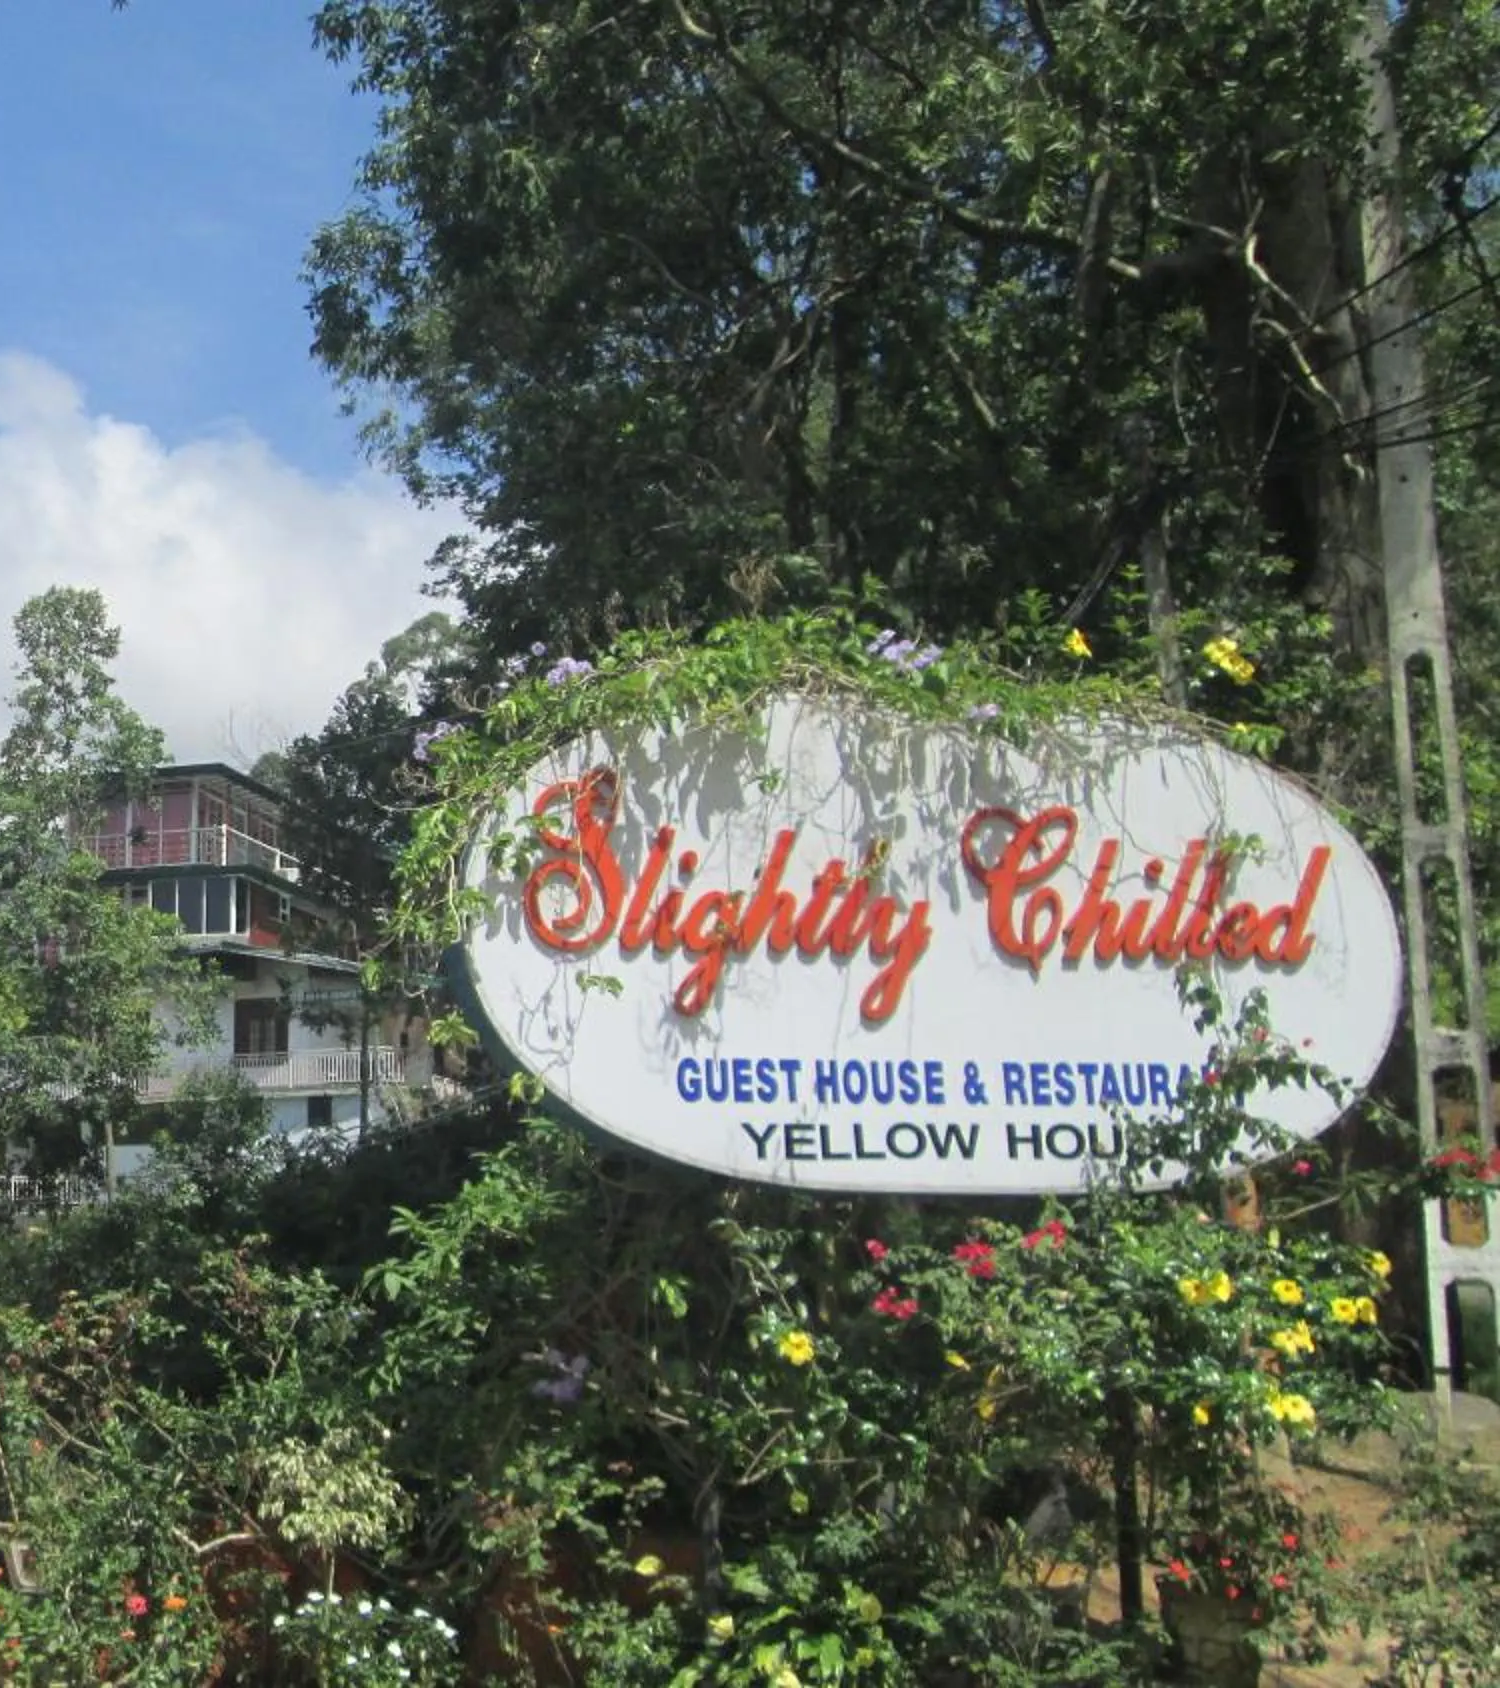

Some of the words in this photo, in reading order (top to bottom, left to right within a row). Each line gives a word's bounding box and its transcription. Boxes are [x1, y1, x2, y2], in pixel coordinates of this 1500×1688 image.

[524, 767, 932, 1022] Slightly
[961, 804, 1333, 974] Chilled
[676, 1057, 802, 1103] GUEST
[815, 1058, 947, 1105] HOUSE
[963, 1060, 990, 1106] &
[741, 1121, 981, 1161] YELLOW
[1005, 1122, 1200, 1161] HOU
